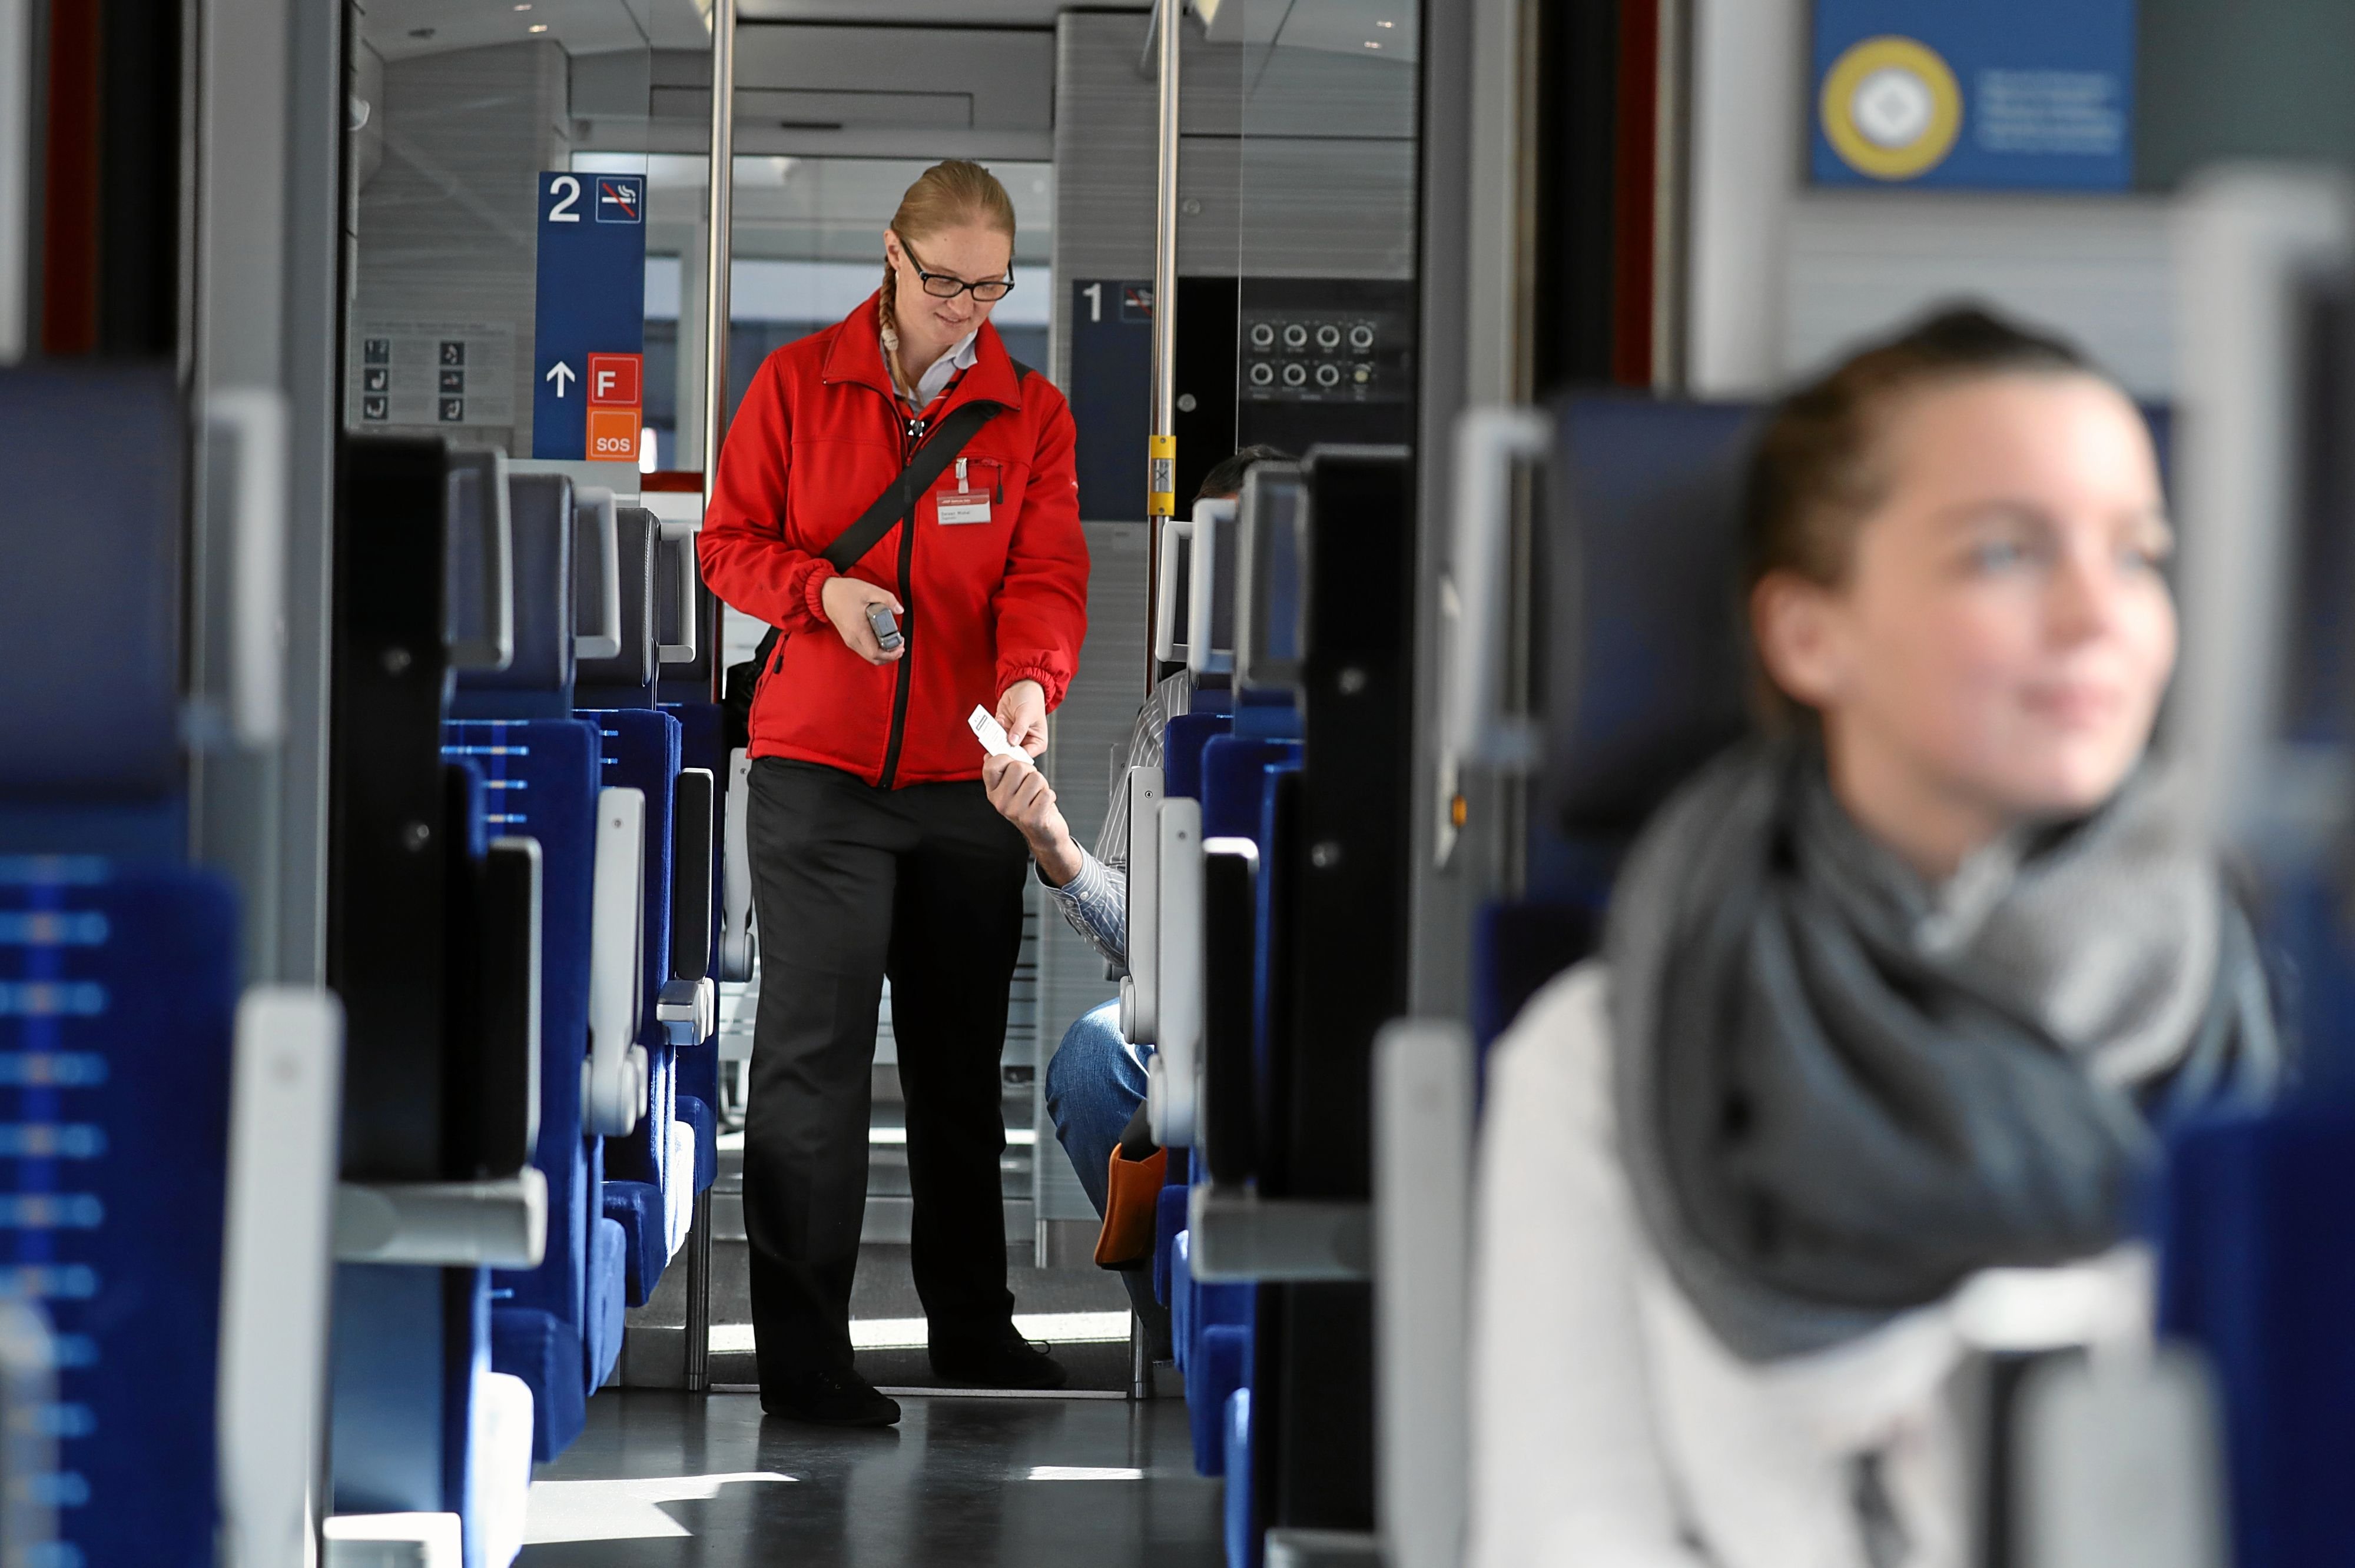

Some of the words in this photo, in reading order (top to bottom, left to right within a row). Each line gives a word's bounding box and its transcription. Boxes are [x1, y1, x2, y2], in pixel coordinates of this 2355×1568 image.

[548, 175, 581, 222] 2
[1083, 283, 1102, 322] 1
[597, 371, 616, 398] F
[596, 437, 631, 452] SOS
